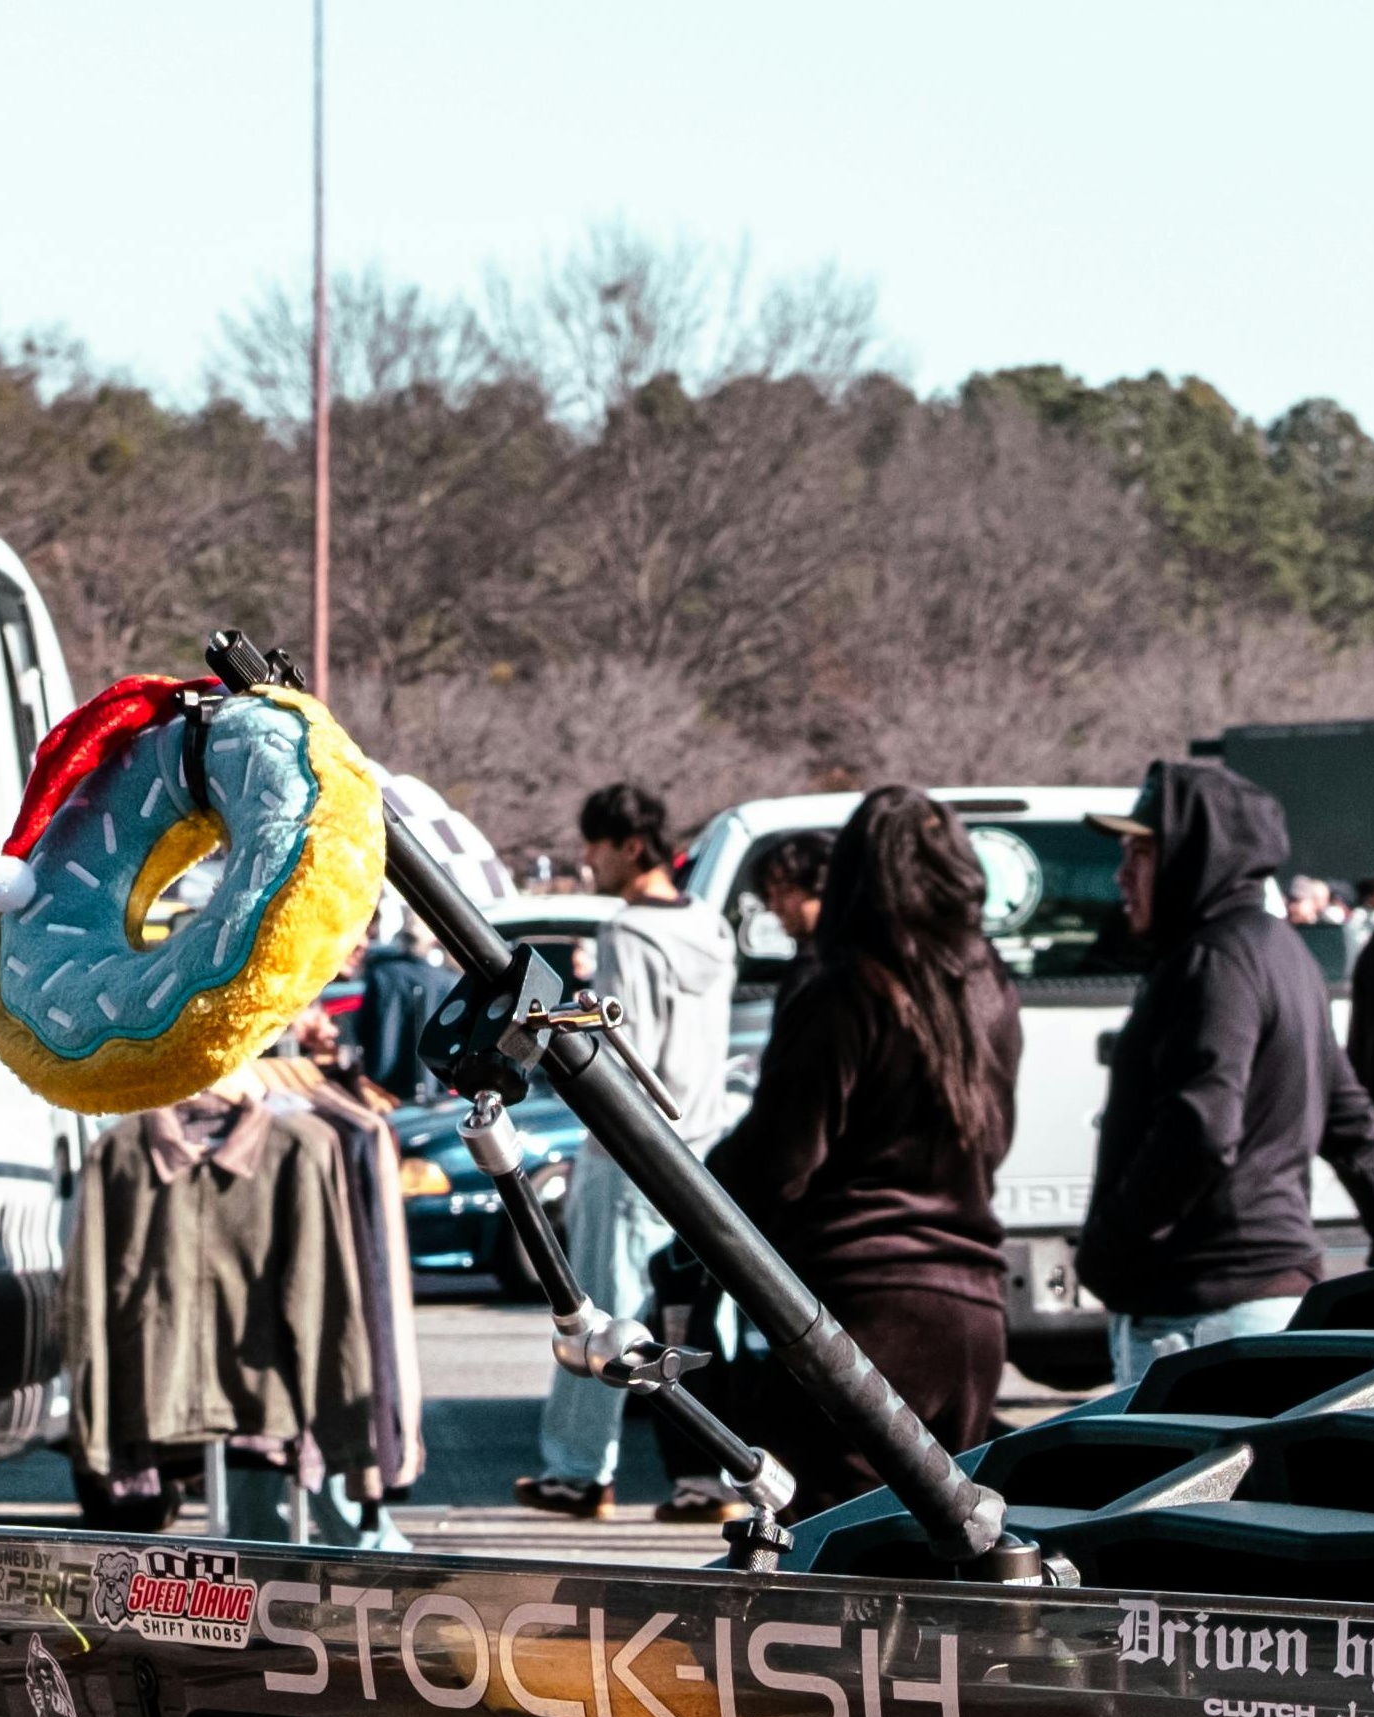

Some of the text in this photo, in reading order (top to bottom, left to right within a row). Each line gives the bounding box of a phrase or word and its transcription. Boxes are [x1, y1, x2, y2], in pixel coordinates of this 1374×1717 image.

[33, 1554, 52, 1571] BY
[128, 1573, 255, 1622] SPEED DAWG
[142, 1619, 242, 1643] SHIFT KNOBS
[1117, 1598, 1309, 1678] Driven
